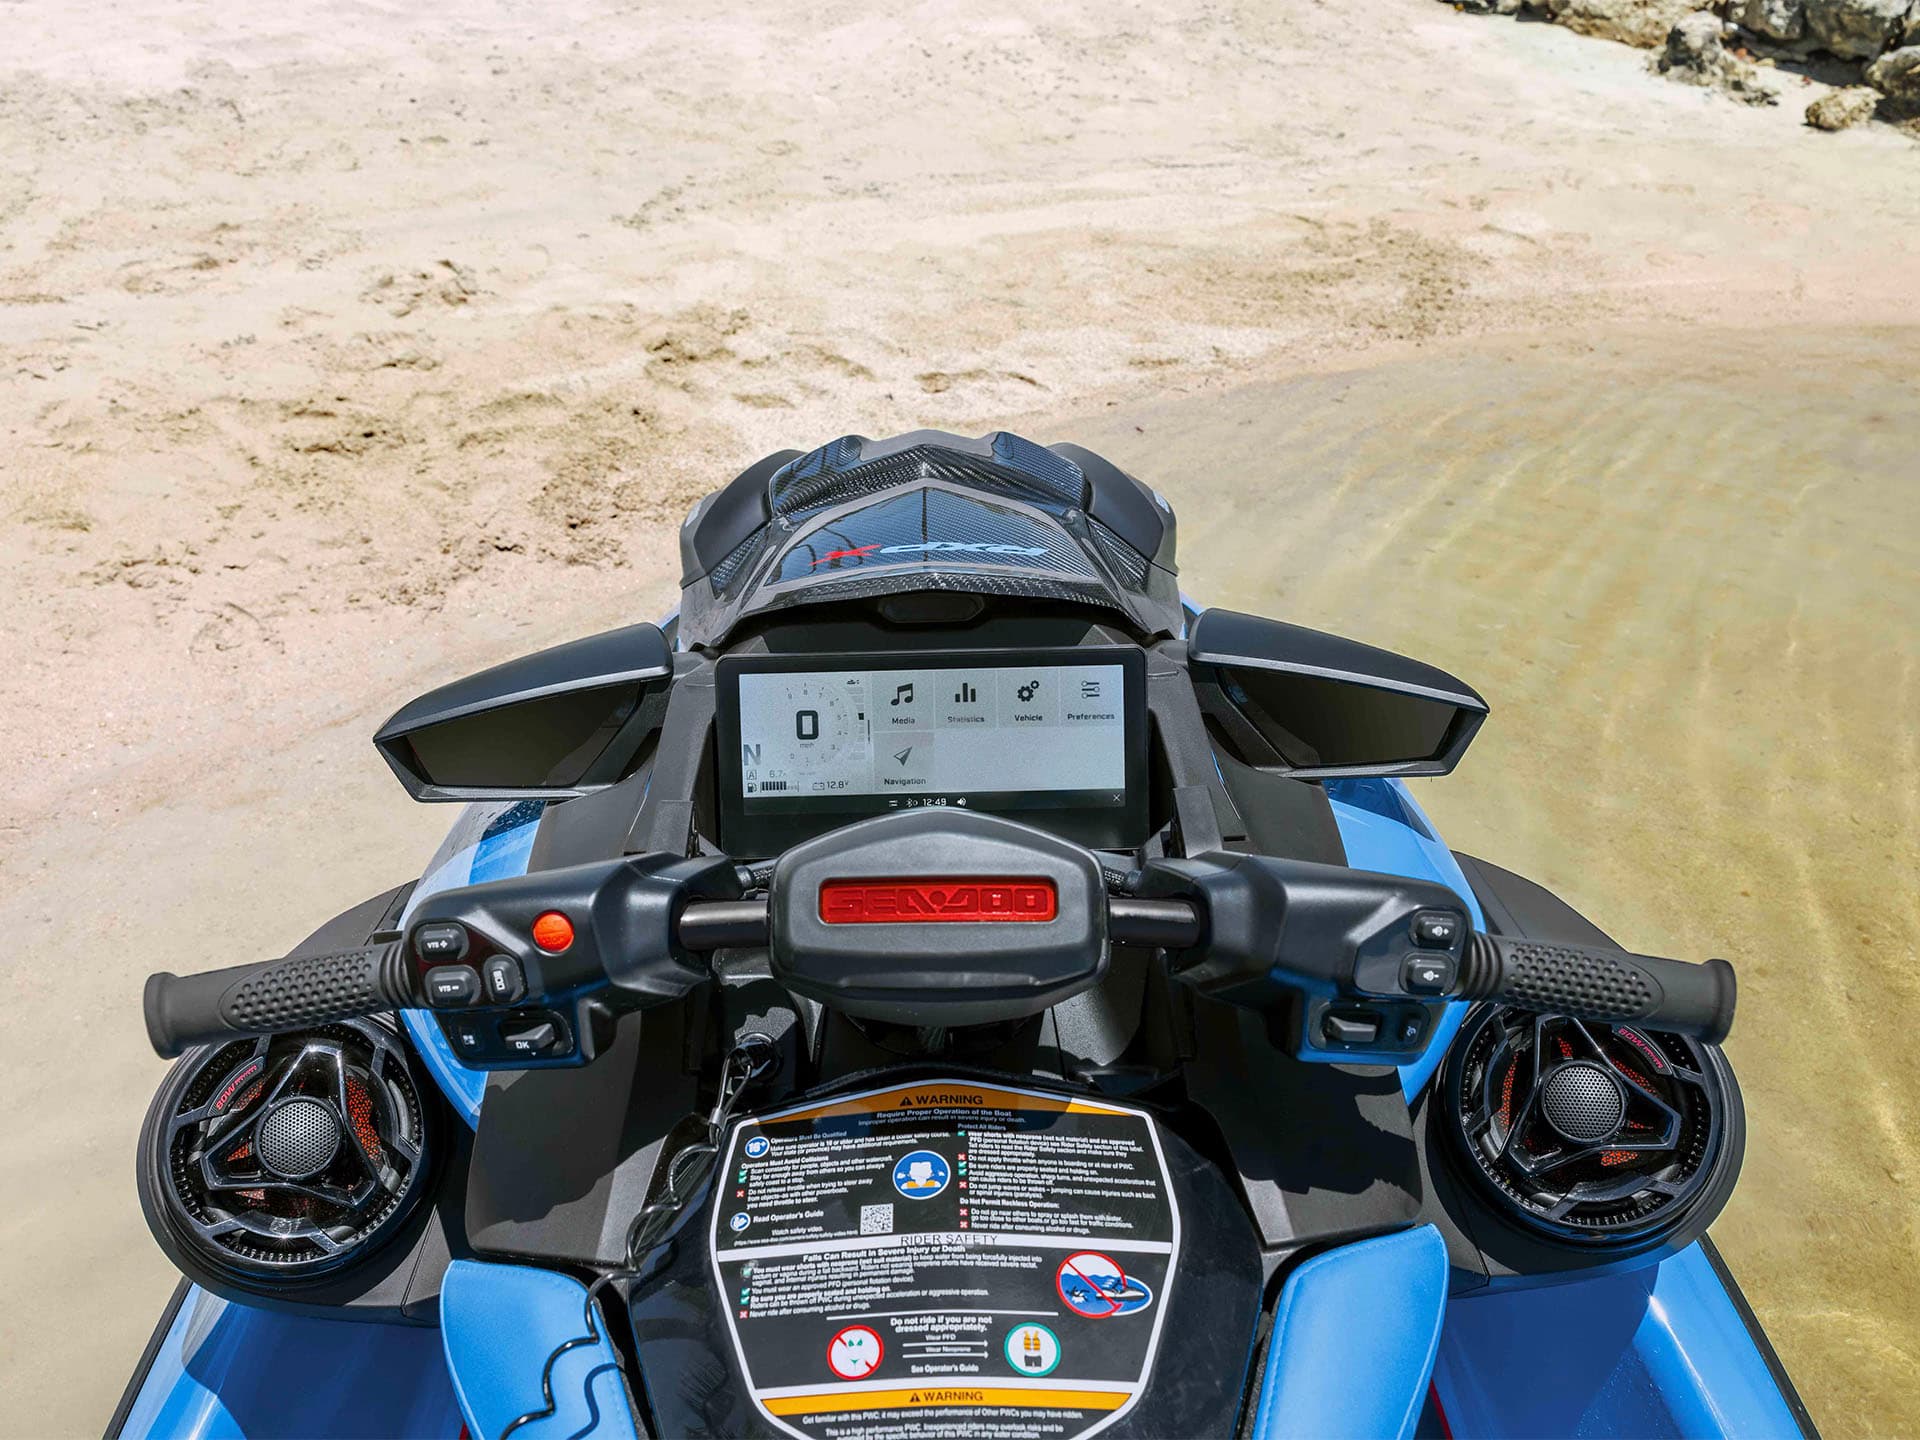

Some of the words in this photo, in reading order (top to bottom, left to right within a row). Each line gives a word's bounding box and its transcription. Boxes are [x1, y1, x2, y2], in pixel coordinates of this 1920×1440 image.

[796, 710, 819, 740] 0
[743, 744, 761, 766] N
[884, 778, 926, 786] Navigation
[922, 798, 947, 806] 12:49
[515, 1041, 530, 1050] OK
[916, 1095, 983, 1105] WARNING
[877, 1111, 905, 1120] Require
[771, 1212, 803, 1222] Operator's
[901, 1235, 940, 1246] RIDER
[944, 1235, 998, 1245] SAFETY
[842, 1250, 866, 1259] Result
[878, 1248, 904, 1256] Severe
[907, 1246, 929, 1255] Injury
[925, 1364, 958, 1374] Operator's
[923, 1392, 983, 1401] WARNING
